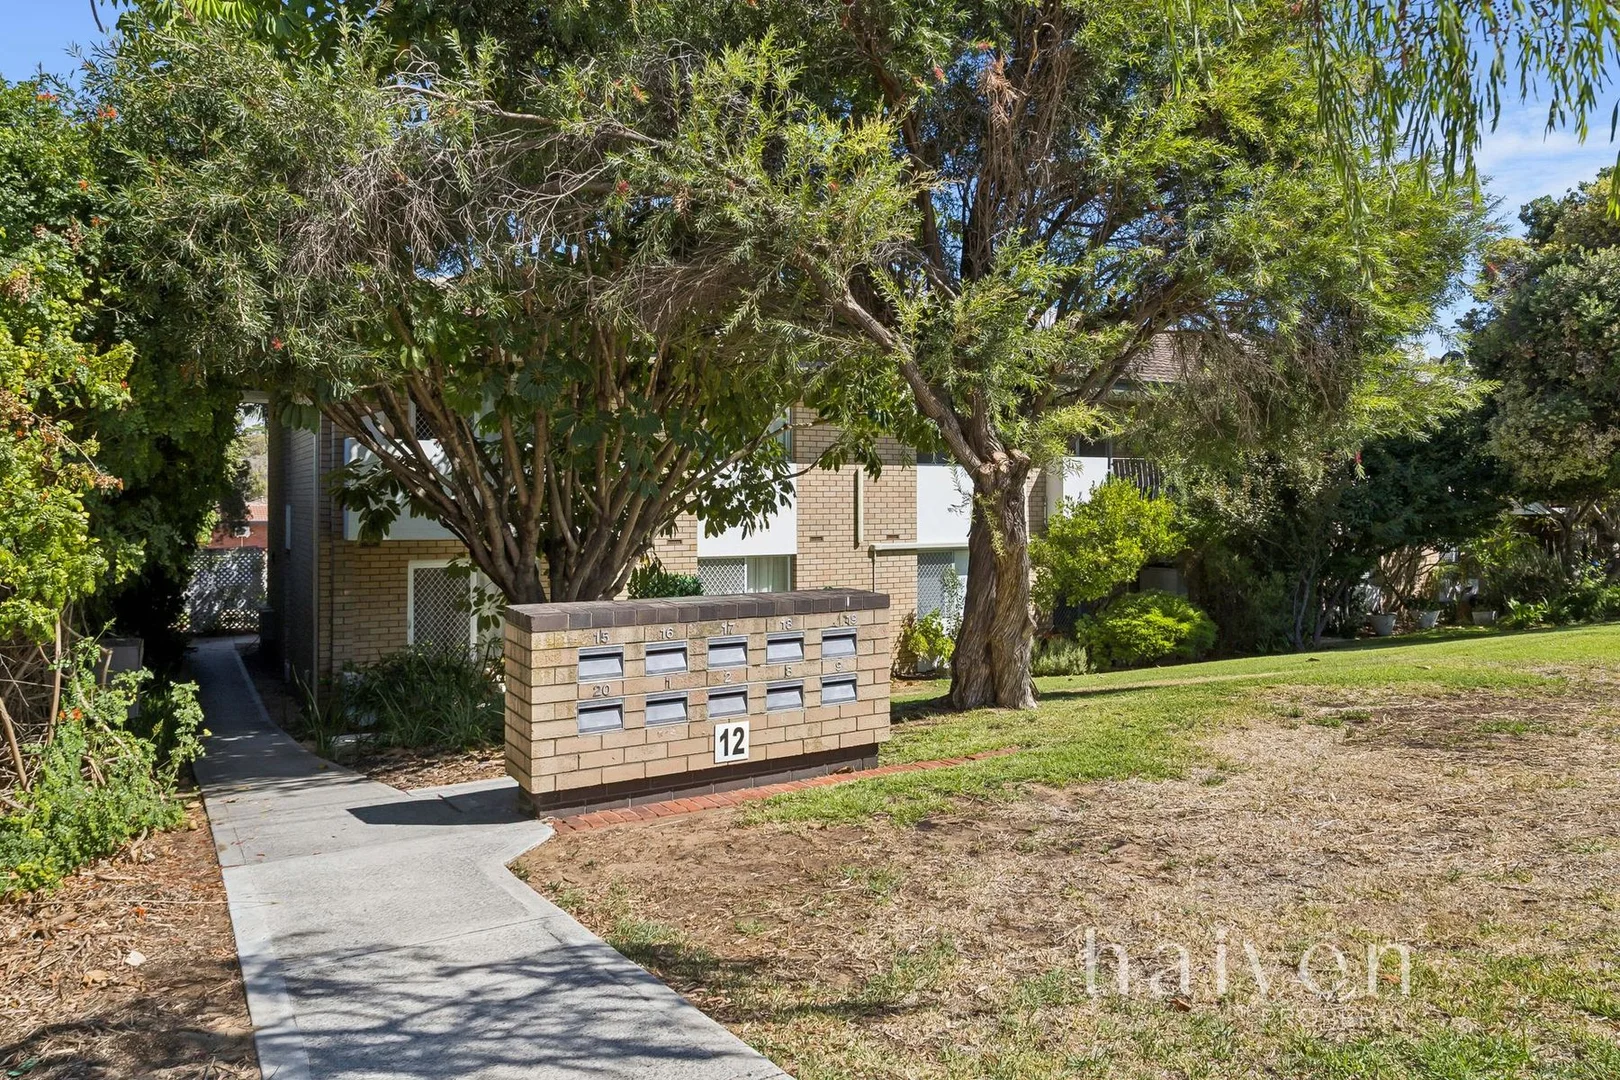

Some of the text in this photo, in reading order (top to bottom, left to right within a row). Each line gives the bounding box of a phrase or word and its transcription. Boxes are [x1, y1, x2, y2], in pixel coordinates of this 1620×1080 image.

[660, 627, 674, 640] 16
[721, 622, 735, 635] 17
[593, 631, 610, 644] 15
[834, 662, 842, 673] 9
[723, 671, 732, 683] 2
[593, 685, 610, 698] 20
[720, 727, 745, 757] 12
